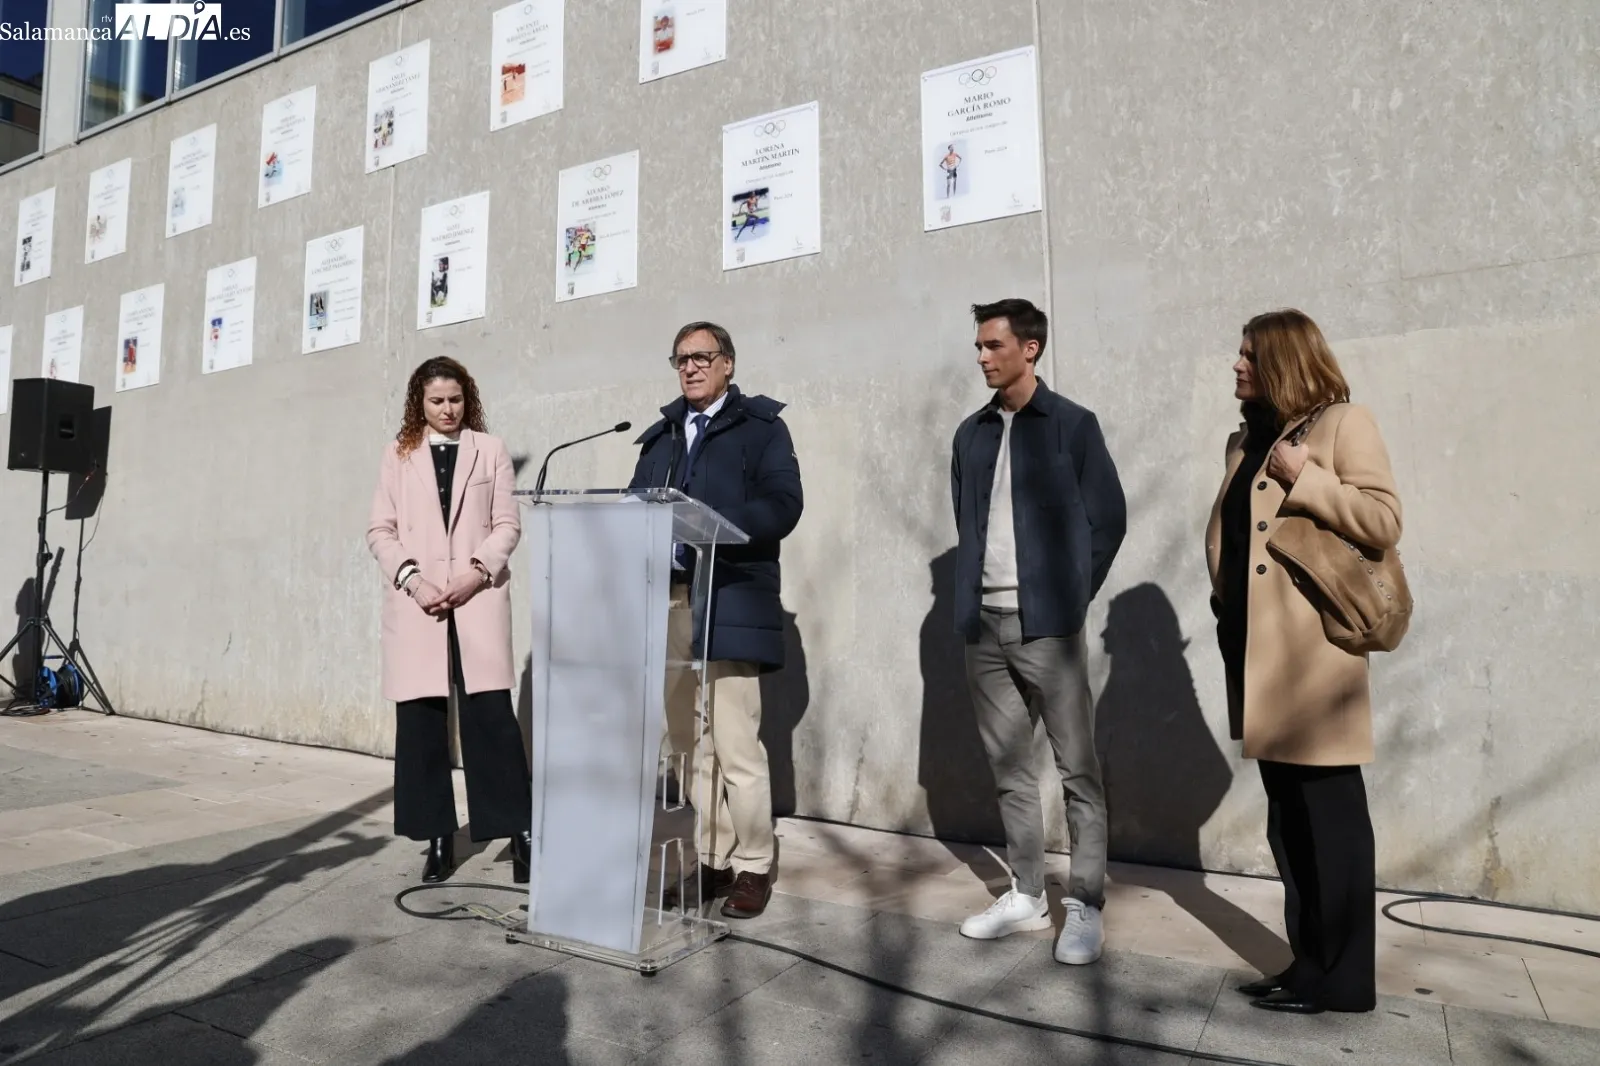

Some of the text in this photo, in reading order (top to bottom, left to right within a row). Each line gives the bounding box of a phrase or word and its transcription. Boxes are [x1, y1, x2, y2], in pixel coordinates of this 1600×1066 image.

[963, 91, 994, 104] MARIO
[947, 97, 1011, 117] GARCÍA ROMO
[755, 142, 785, 155] LORENA
